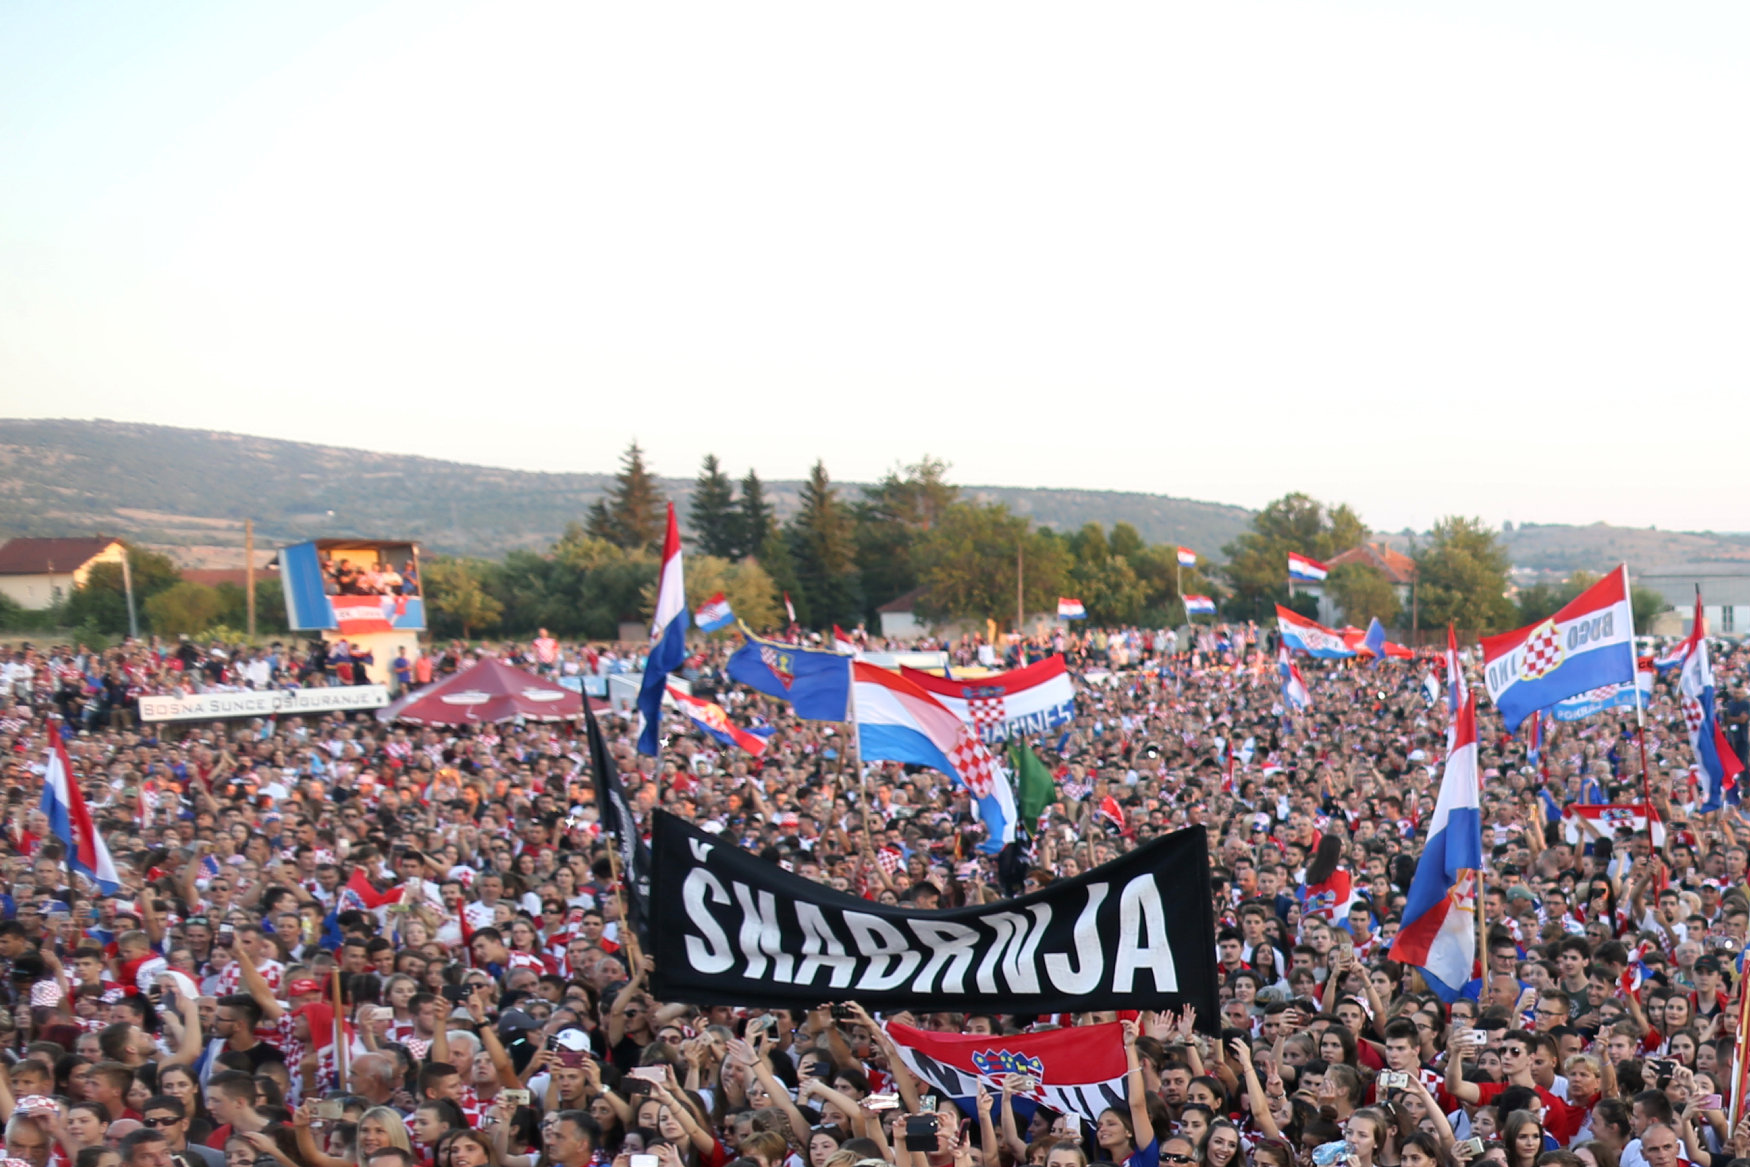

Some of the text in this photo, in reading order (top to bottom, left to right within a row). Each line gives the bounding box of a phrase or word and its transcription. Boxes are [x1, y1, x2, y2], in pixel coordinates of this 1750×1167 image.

[144, 693, 369, 716] BOSNA SUNCE OSIGURANJE
[682, 837, 1179, 995] ŠKABRNJA
